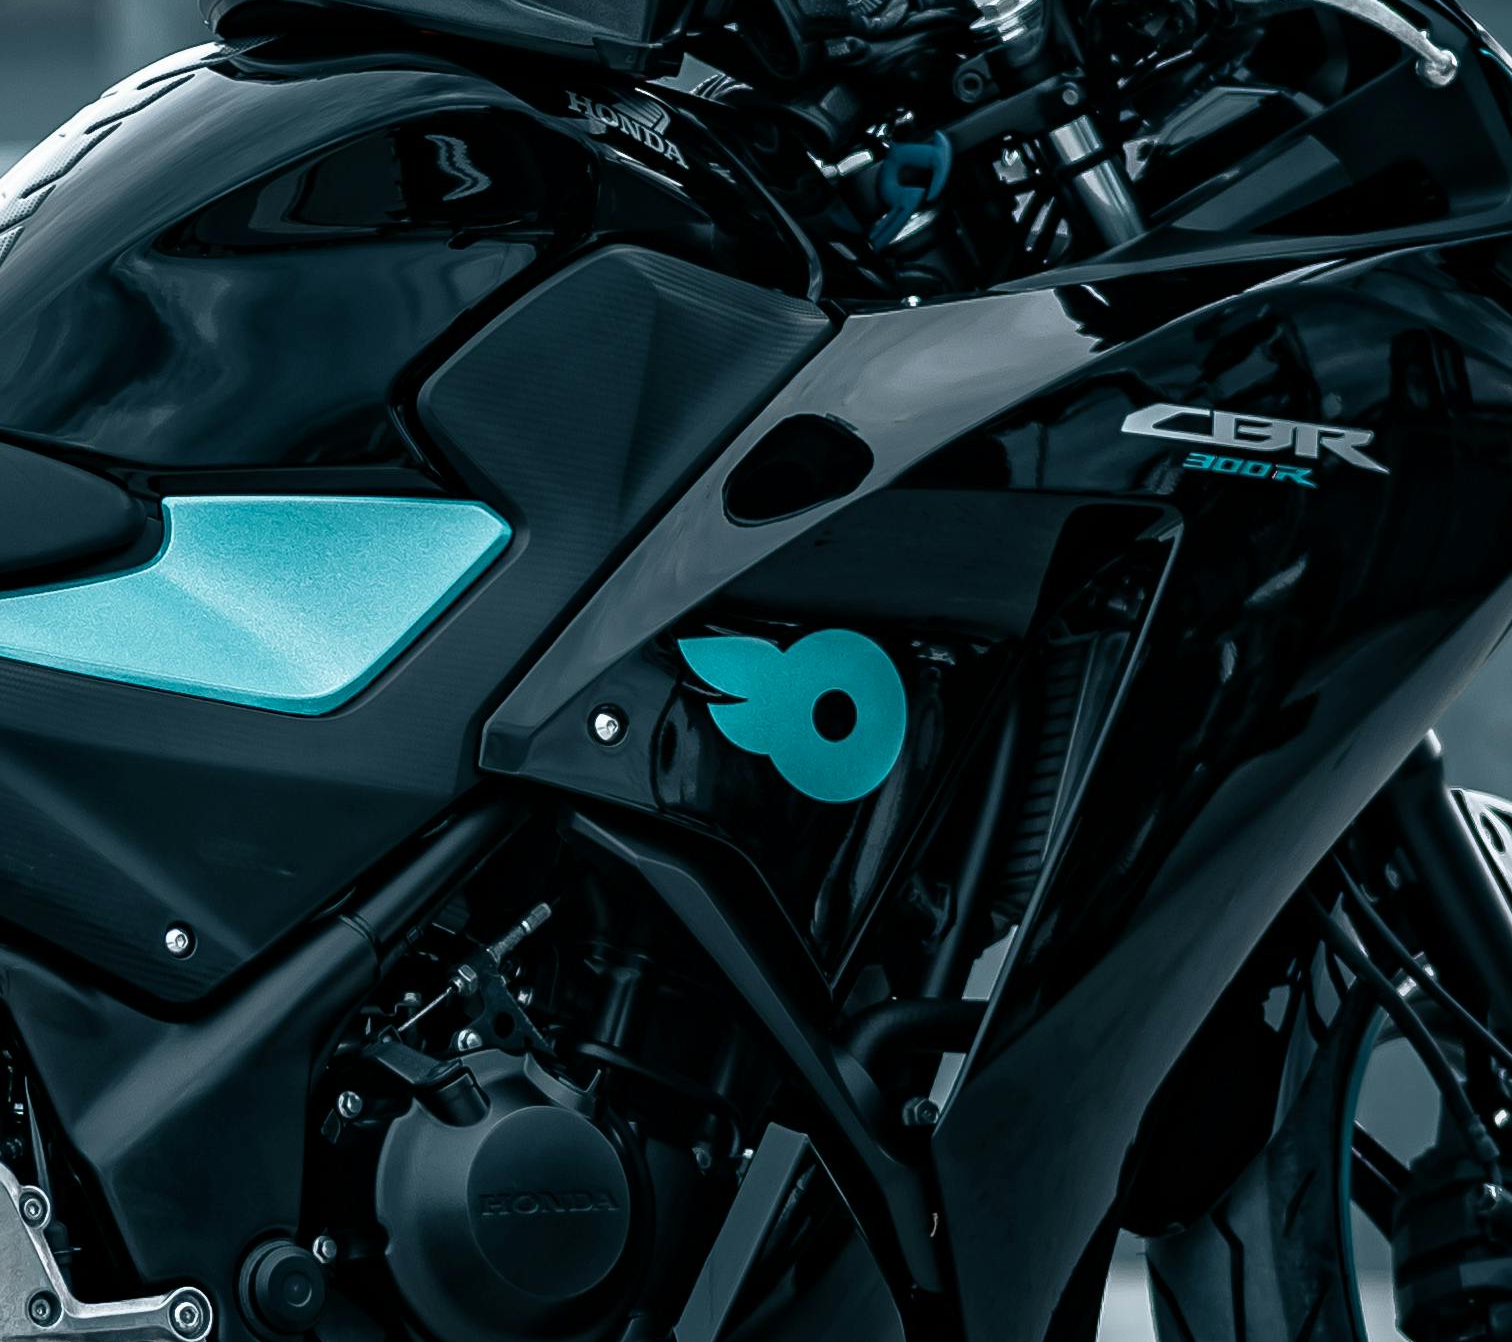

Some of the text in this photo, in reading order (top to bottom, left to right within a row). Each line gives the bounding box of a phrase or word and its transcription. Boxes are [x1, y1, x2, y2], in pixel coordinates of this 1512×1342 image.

[563, 89, 689, 170] HONDA
[1121, 403, 1389, 474] CBR
[1182, 452, 1317, 488] 300R
[479, 1188, 621, 1216] HONDA
